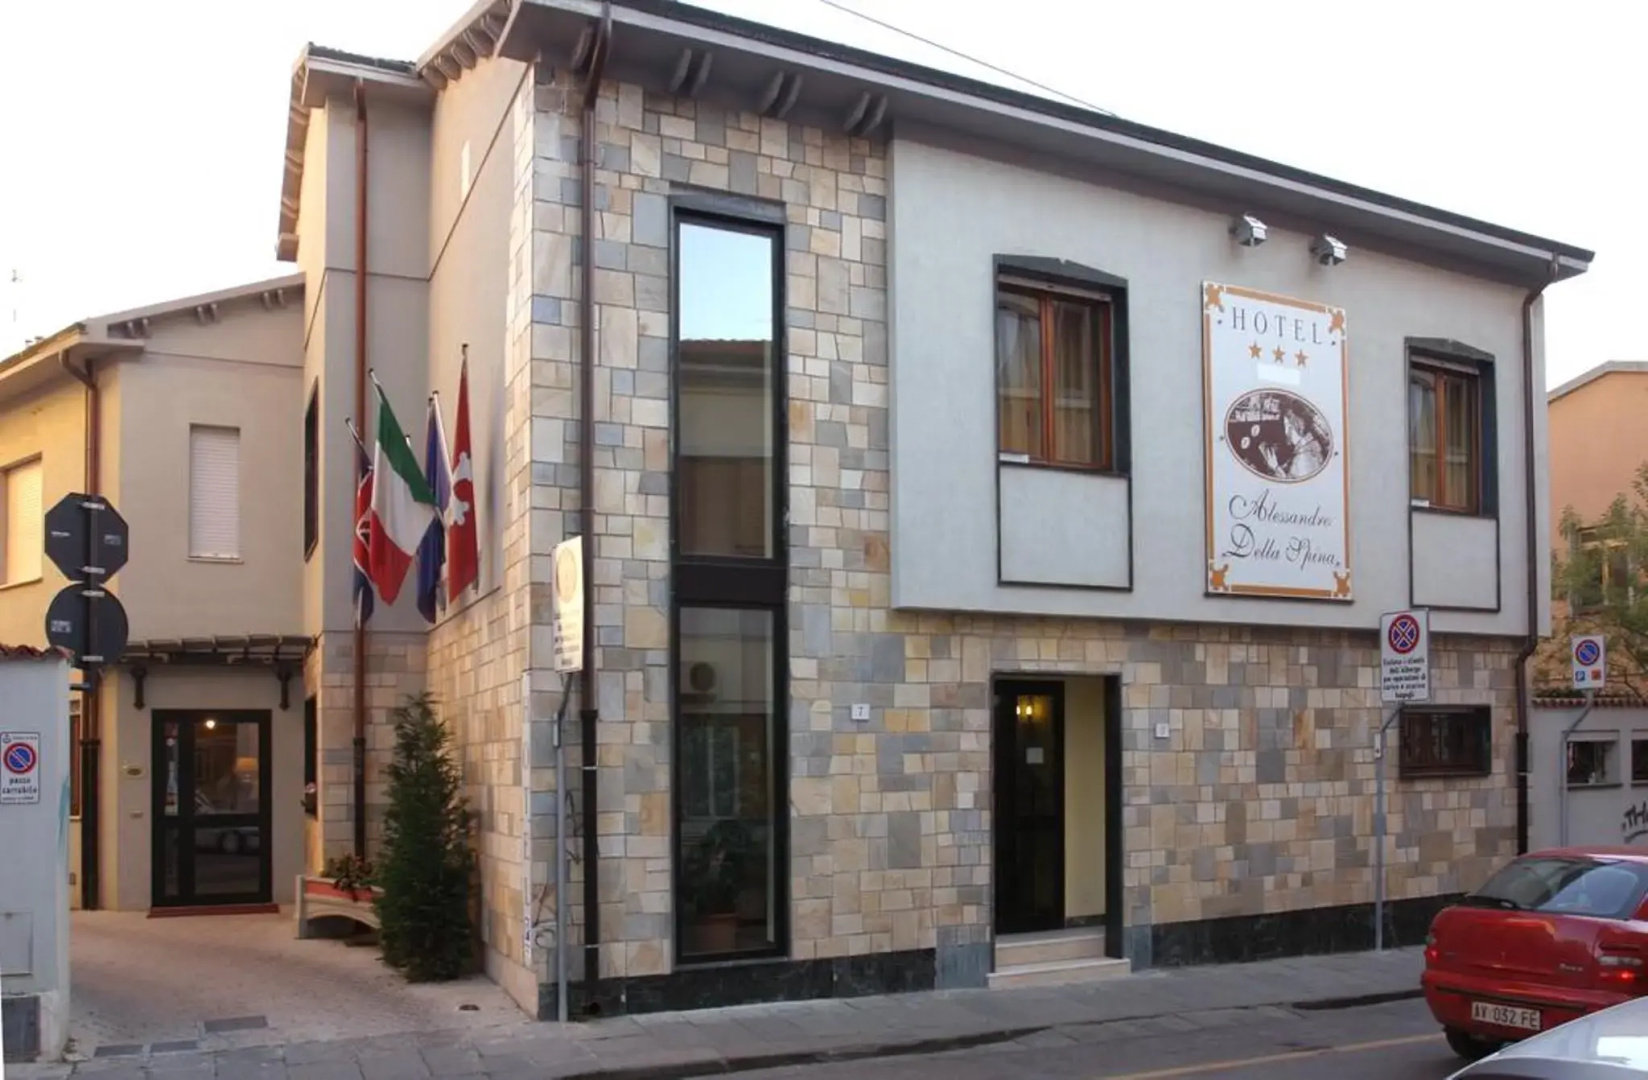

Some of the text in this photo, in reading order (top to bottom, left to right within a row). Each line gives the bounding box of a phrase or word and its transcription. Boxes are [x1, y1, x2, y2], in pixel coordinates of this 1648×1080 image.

[1232, 306, 1322, 345] HOTEL
[1229, 488, 1332, 528] Alessandro
[1223, 523, 1280, 559] Della
[1474, 1003, 1538, 1028] AV 032 FE
